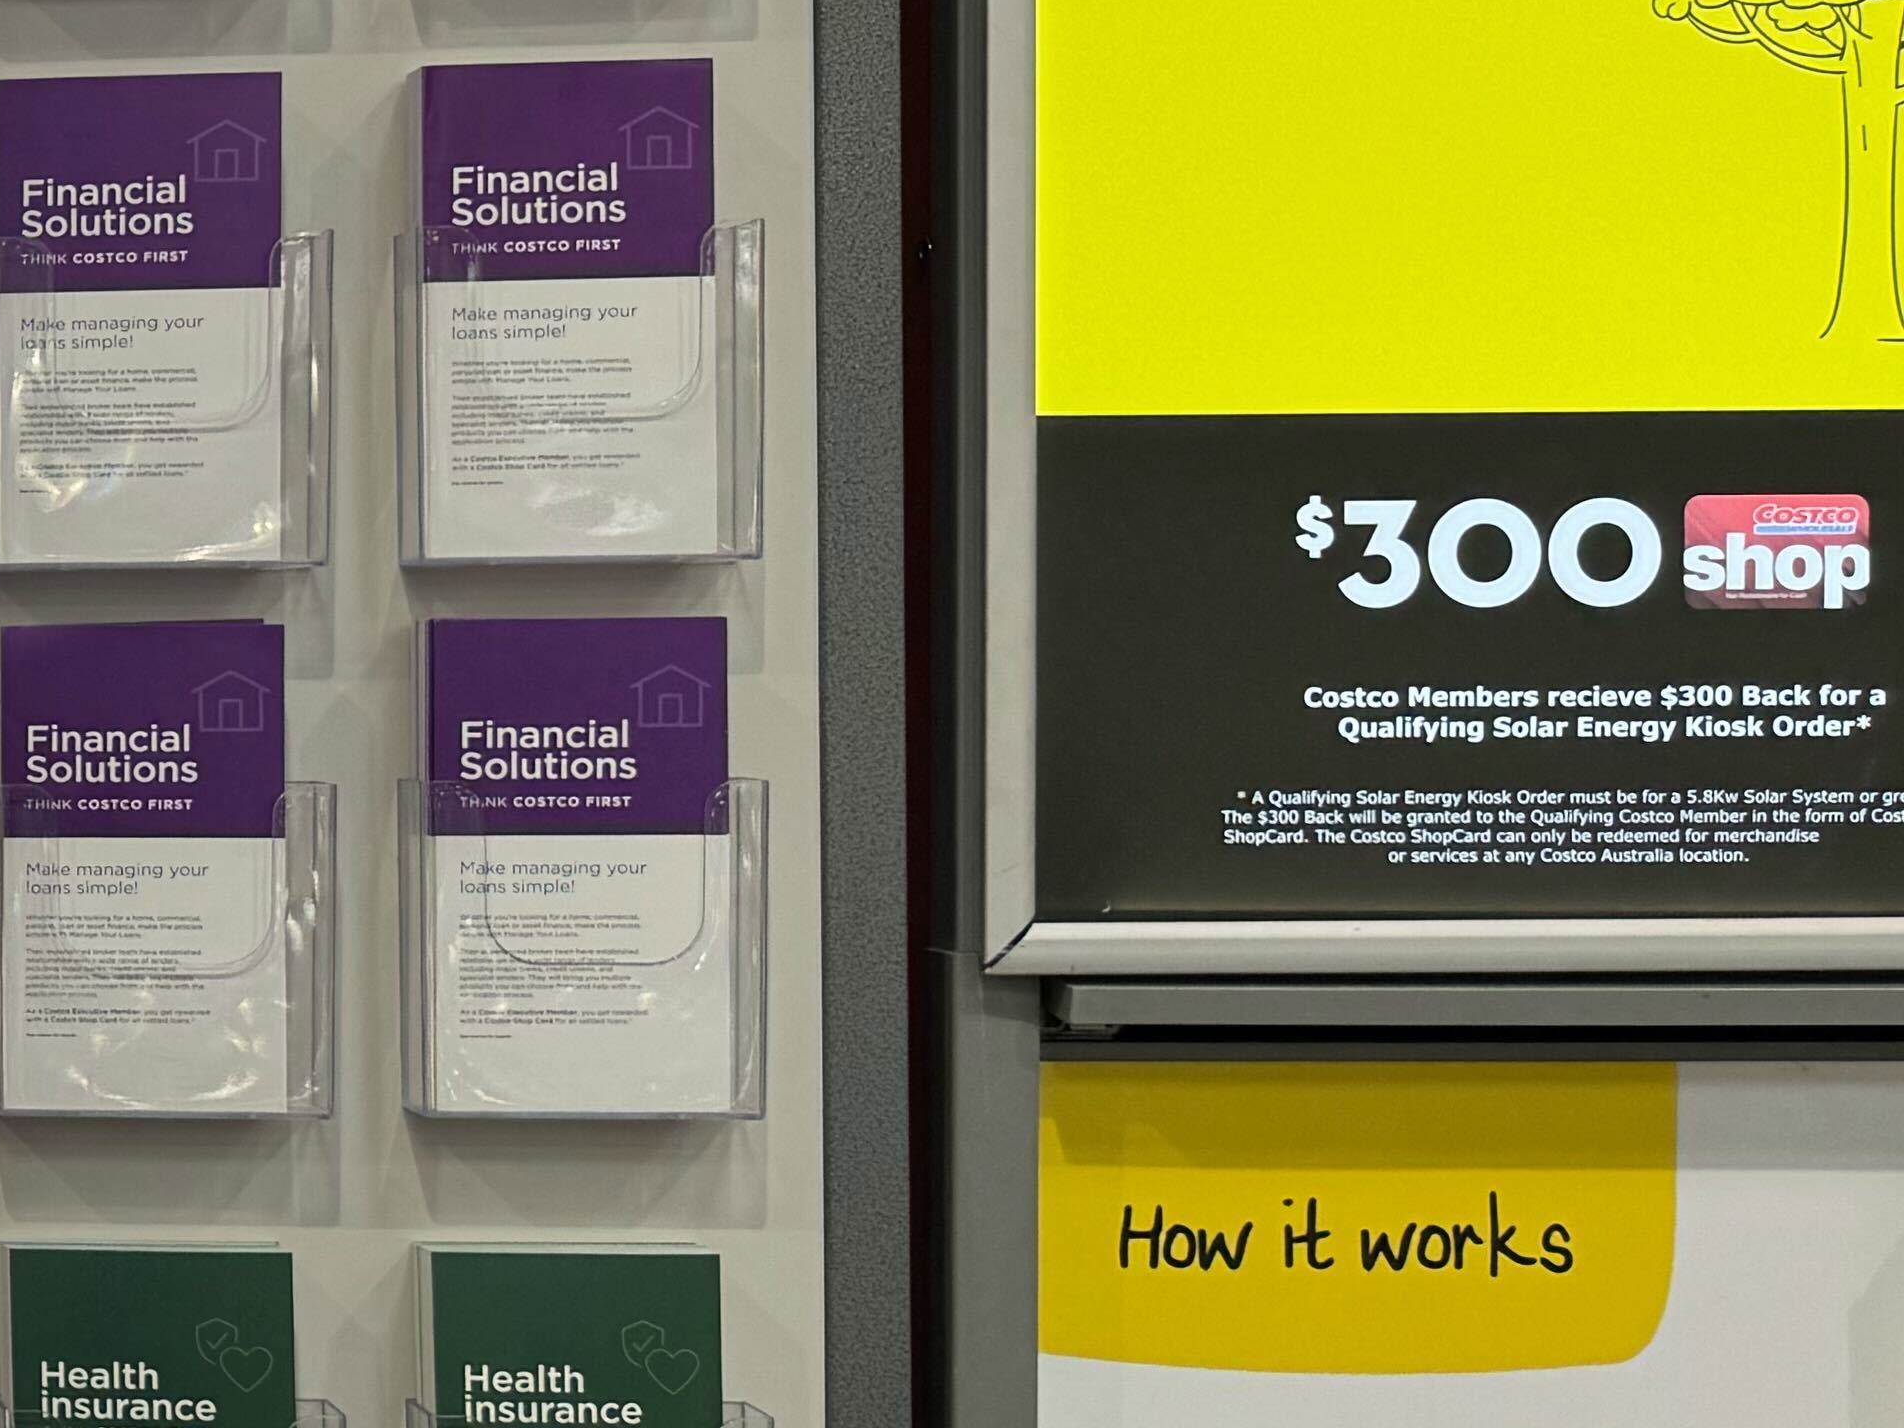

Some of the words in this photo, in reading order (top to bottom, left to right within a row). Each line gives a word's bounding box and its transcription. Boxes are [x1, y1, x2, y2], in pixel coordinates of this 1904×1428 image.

[1752, 503, 1859, 525] COSTCO
[1295, 494, 1662, 609] $300
[1683, 532, 1870, 608] shop
[1304, 686, 1401, 708] Costco
[1408, 685, 1539, 707] Members
[1548, 685, 1652, 707] recieve
[1659, 684, 1733, 711] $300
[1742, 685, 1808, 707] Back
[1818, 684, 1859, 706] for
[1866, 690, 1886, 706] a
[26, 723, 191, 753] Financial
[1338, 715, 1485, 743] Qualifying
[1492, 714, 1571, 737] Solar
[1578, 716, 1676, 743] Energy
[1685, 714, 1764, 736] Kiosk
[26, 755, 198, 784] Solutions
[78, 797, 142, 811] COSTCO
[148, 797, 193, 811] FIRST
[26, 862, 71, 876] Make
[76, 863, 163, 879] managing
[169, 864, 209, 879] your
[1388, 850, 1406, 863] or
[1411, 849, 1479, 863] services
[1484, 850, 1499, 863] at
[1505, 851, 1536, 866] any
[1541, 849, 1595, 863] Costco
[1601, 848, 1673, 862] Australia
[1679, 848, 1749, 863] location.
[26, 879, 71, 894] loans
[76, 880, 138, 897] simple!
[1119, 1204, 1253, 1272] How
[1284, 1198, 1334, 1271] it
[1361, 1190, 1574, 1278] works
[40, 1359, 158, 1391] Health
[40, 1390, 217, 1422] insurance
